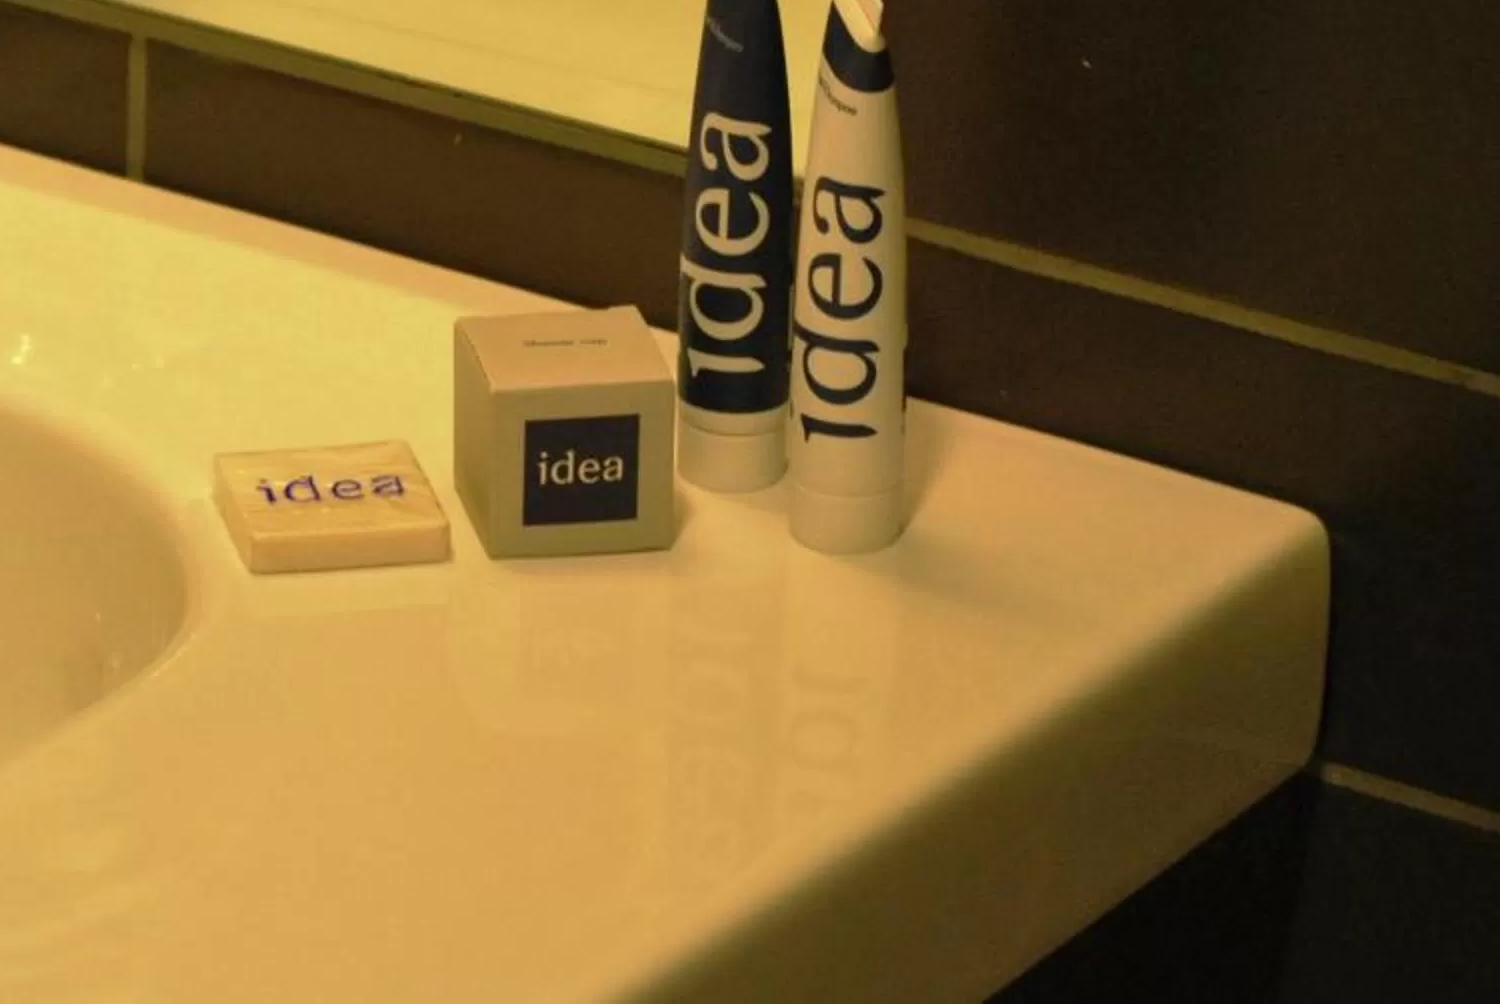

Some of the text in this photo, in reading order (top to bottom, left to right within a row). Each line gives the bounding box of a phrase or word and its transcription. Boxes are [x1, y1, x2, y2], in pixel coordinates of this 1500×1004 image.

[680, 113, 771, 377] idea
[794, 176, 886, 443] idea
[256, 474, 406, 505] idea
[537, 451, 624, 485] idea
